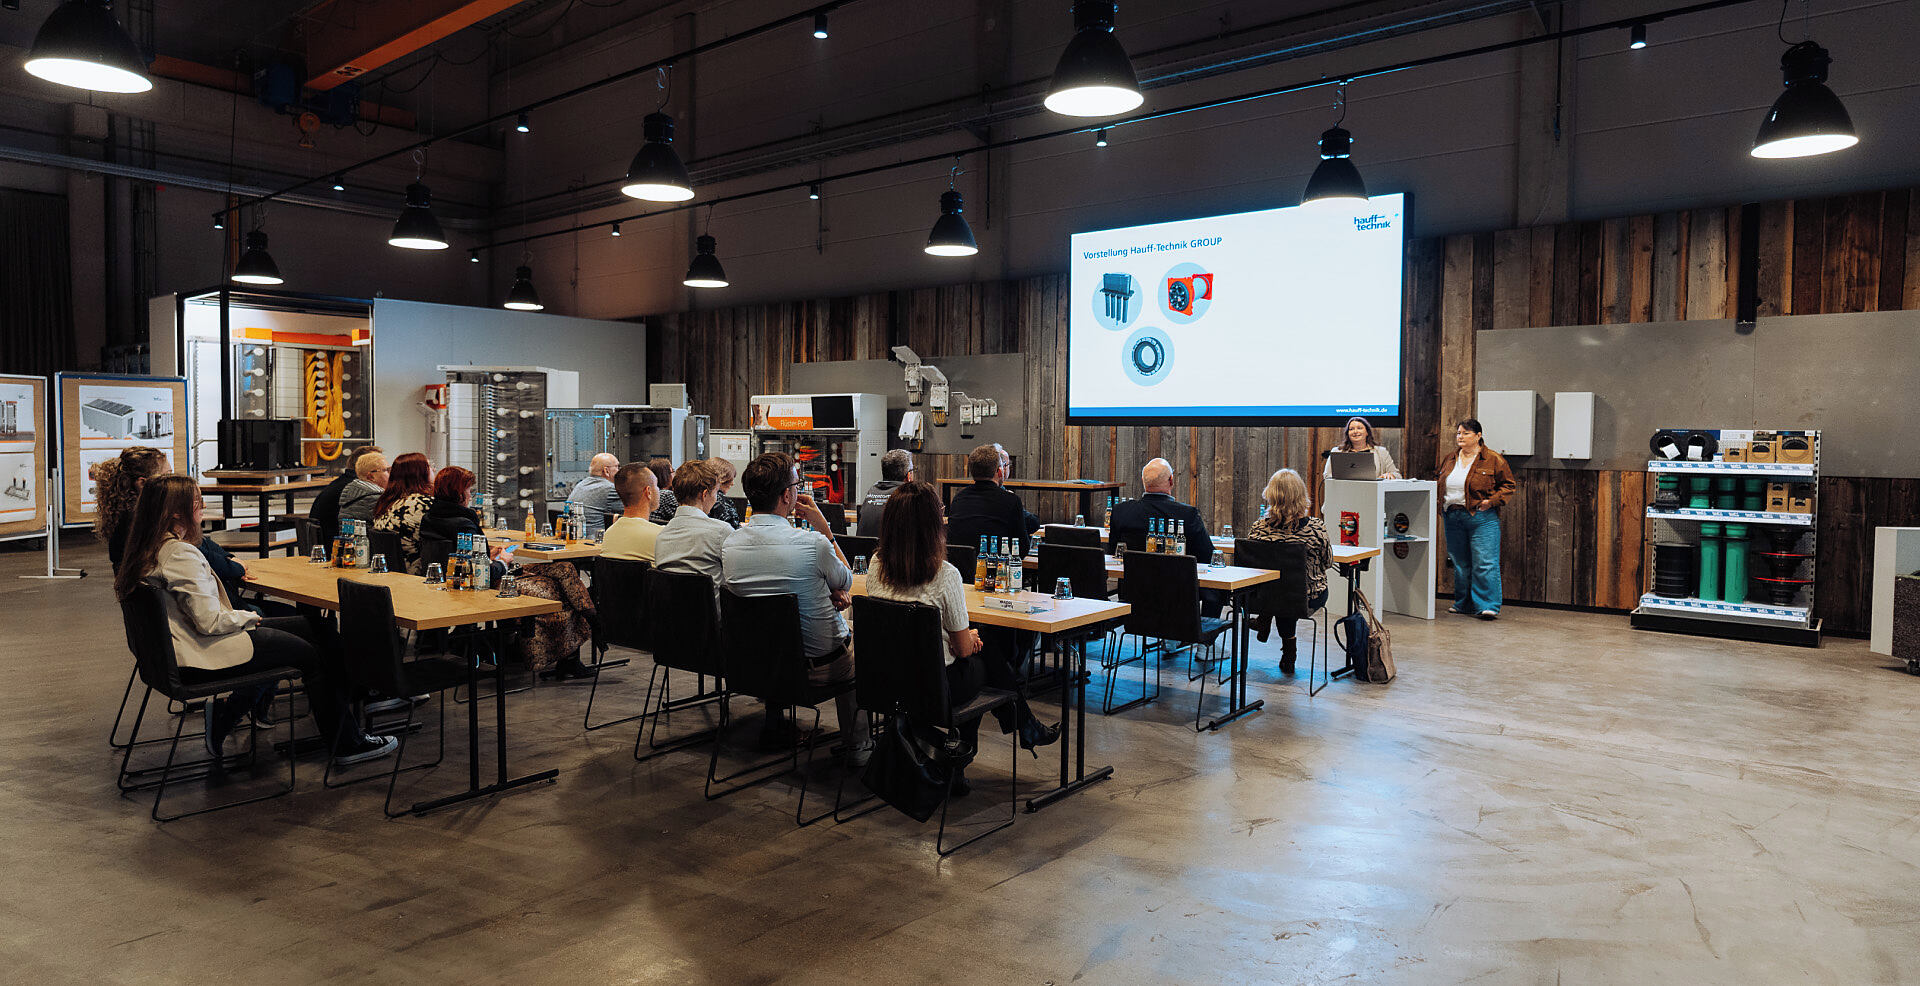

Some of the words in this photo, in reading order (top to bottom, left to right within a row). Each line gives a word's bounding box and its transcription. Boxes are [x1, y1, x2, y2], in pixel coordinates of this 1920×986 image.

[1357, 220, 1391, 231] technik
[1083, 248, 1128, 260] Vorstellung
[1130, 240, 1188, 255] Hauff-Technik
[1190, 236, 1223, 248] GROUP
